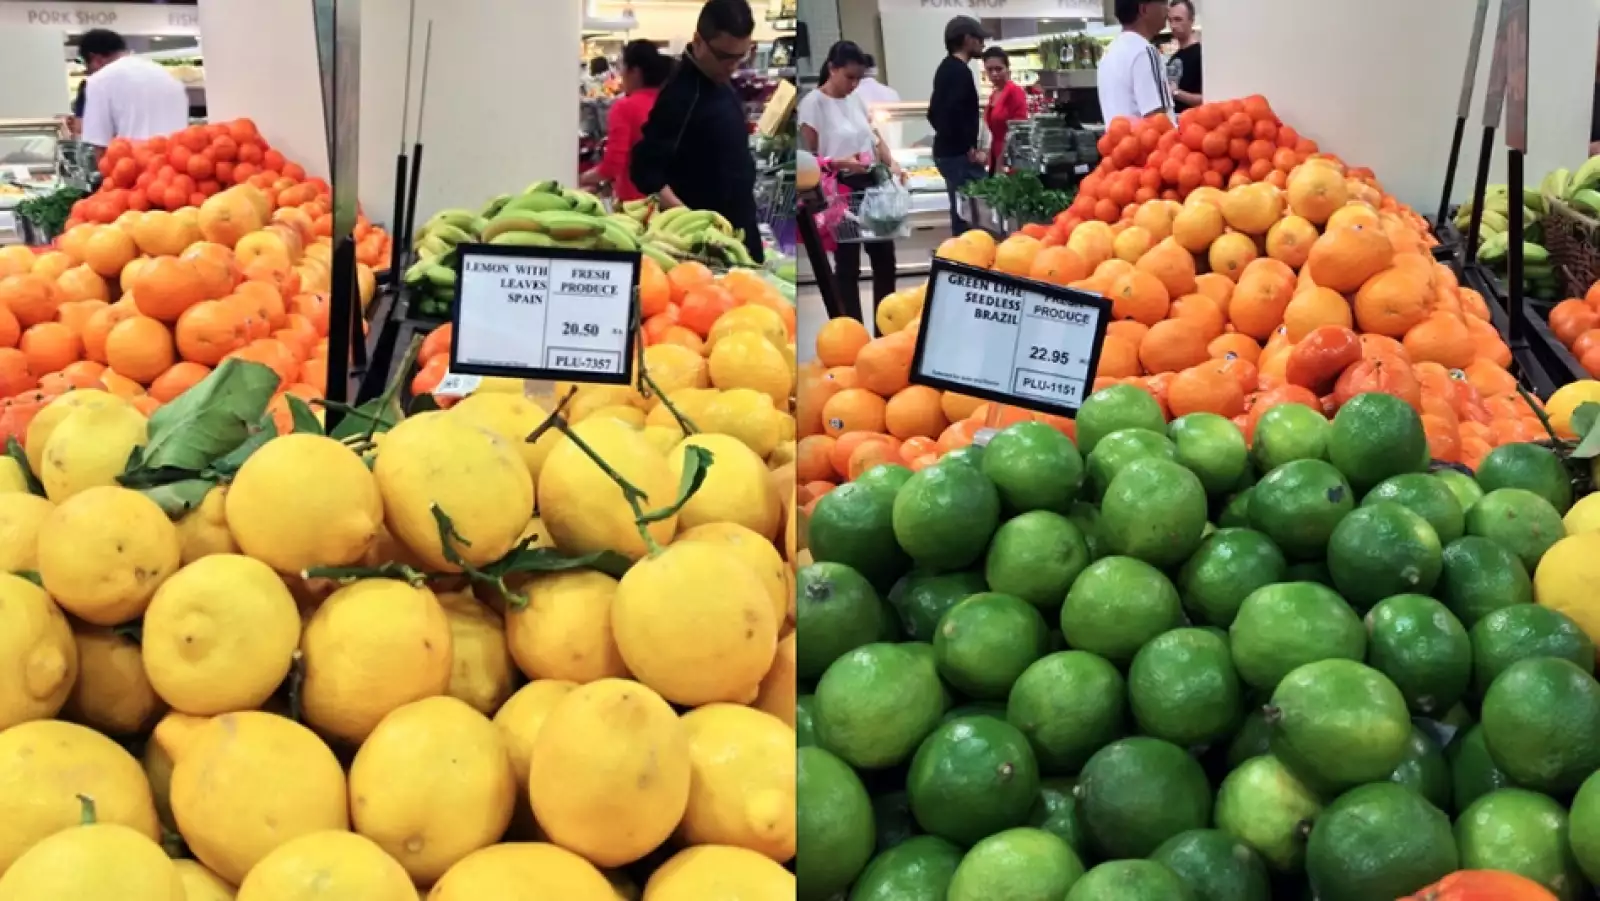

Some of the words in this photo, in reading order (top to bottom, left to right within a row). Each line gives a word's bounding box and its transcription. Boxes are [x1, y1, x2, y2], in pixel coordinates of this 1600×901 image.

[28, 10, 71, 24] PORK
[75, 11, 117, 25] SHOP
[465, 262, 509, 274] LEMON
[516, 265, 548, 276] WITH
[571, 269, 611, 281] FRESH
[500, 278, 548, 290] LEAVES
[560, 282, 619, 296] PRODUCE
[947, 273, 989, 291] GREEN
[507, 293, 543, 305] SPAIN
[964, 291, 1021, 312] SEEDLESS
[974, 307, 1019, 325] BRAZIL
[1033, 304, 1091, 325] PRODUCE
[562, 321, 600, 337] 20.50
[556, 355, 612, 369] PLU-7357
[1029, 345, 1070, 366] 22.95
[1022, 377, 1076, 396] PLU-1151
